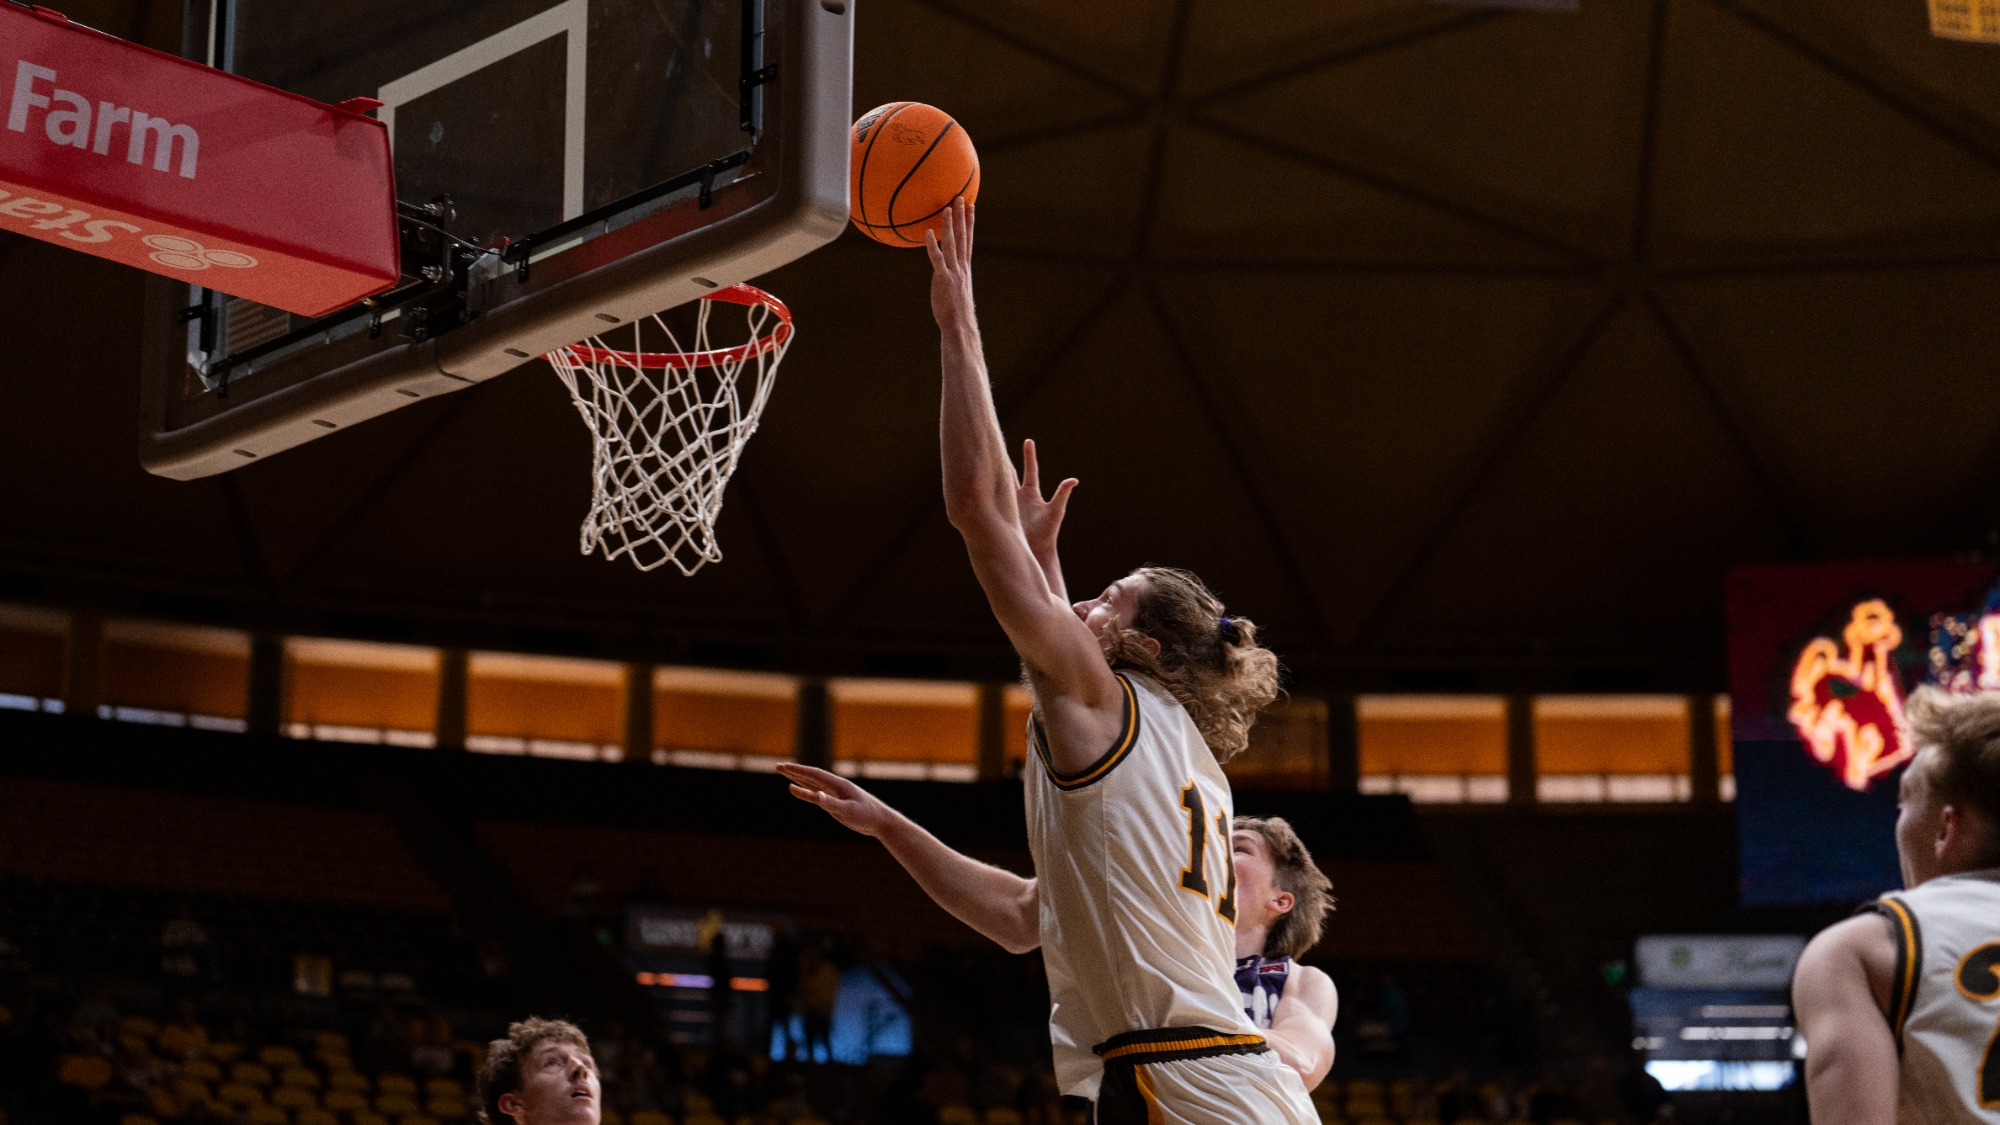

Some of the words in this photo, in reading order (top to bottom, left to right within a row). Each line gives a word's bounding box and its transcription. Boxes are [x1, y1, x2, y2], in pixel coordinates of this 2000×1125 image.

[6, 59, 200, 180] Farm
[0, 188, 142, 244] Sta
[1179, 777, 1238, 929] 11
